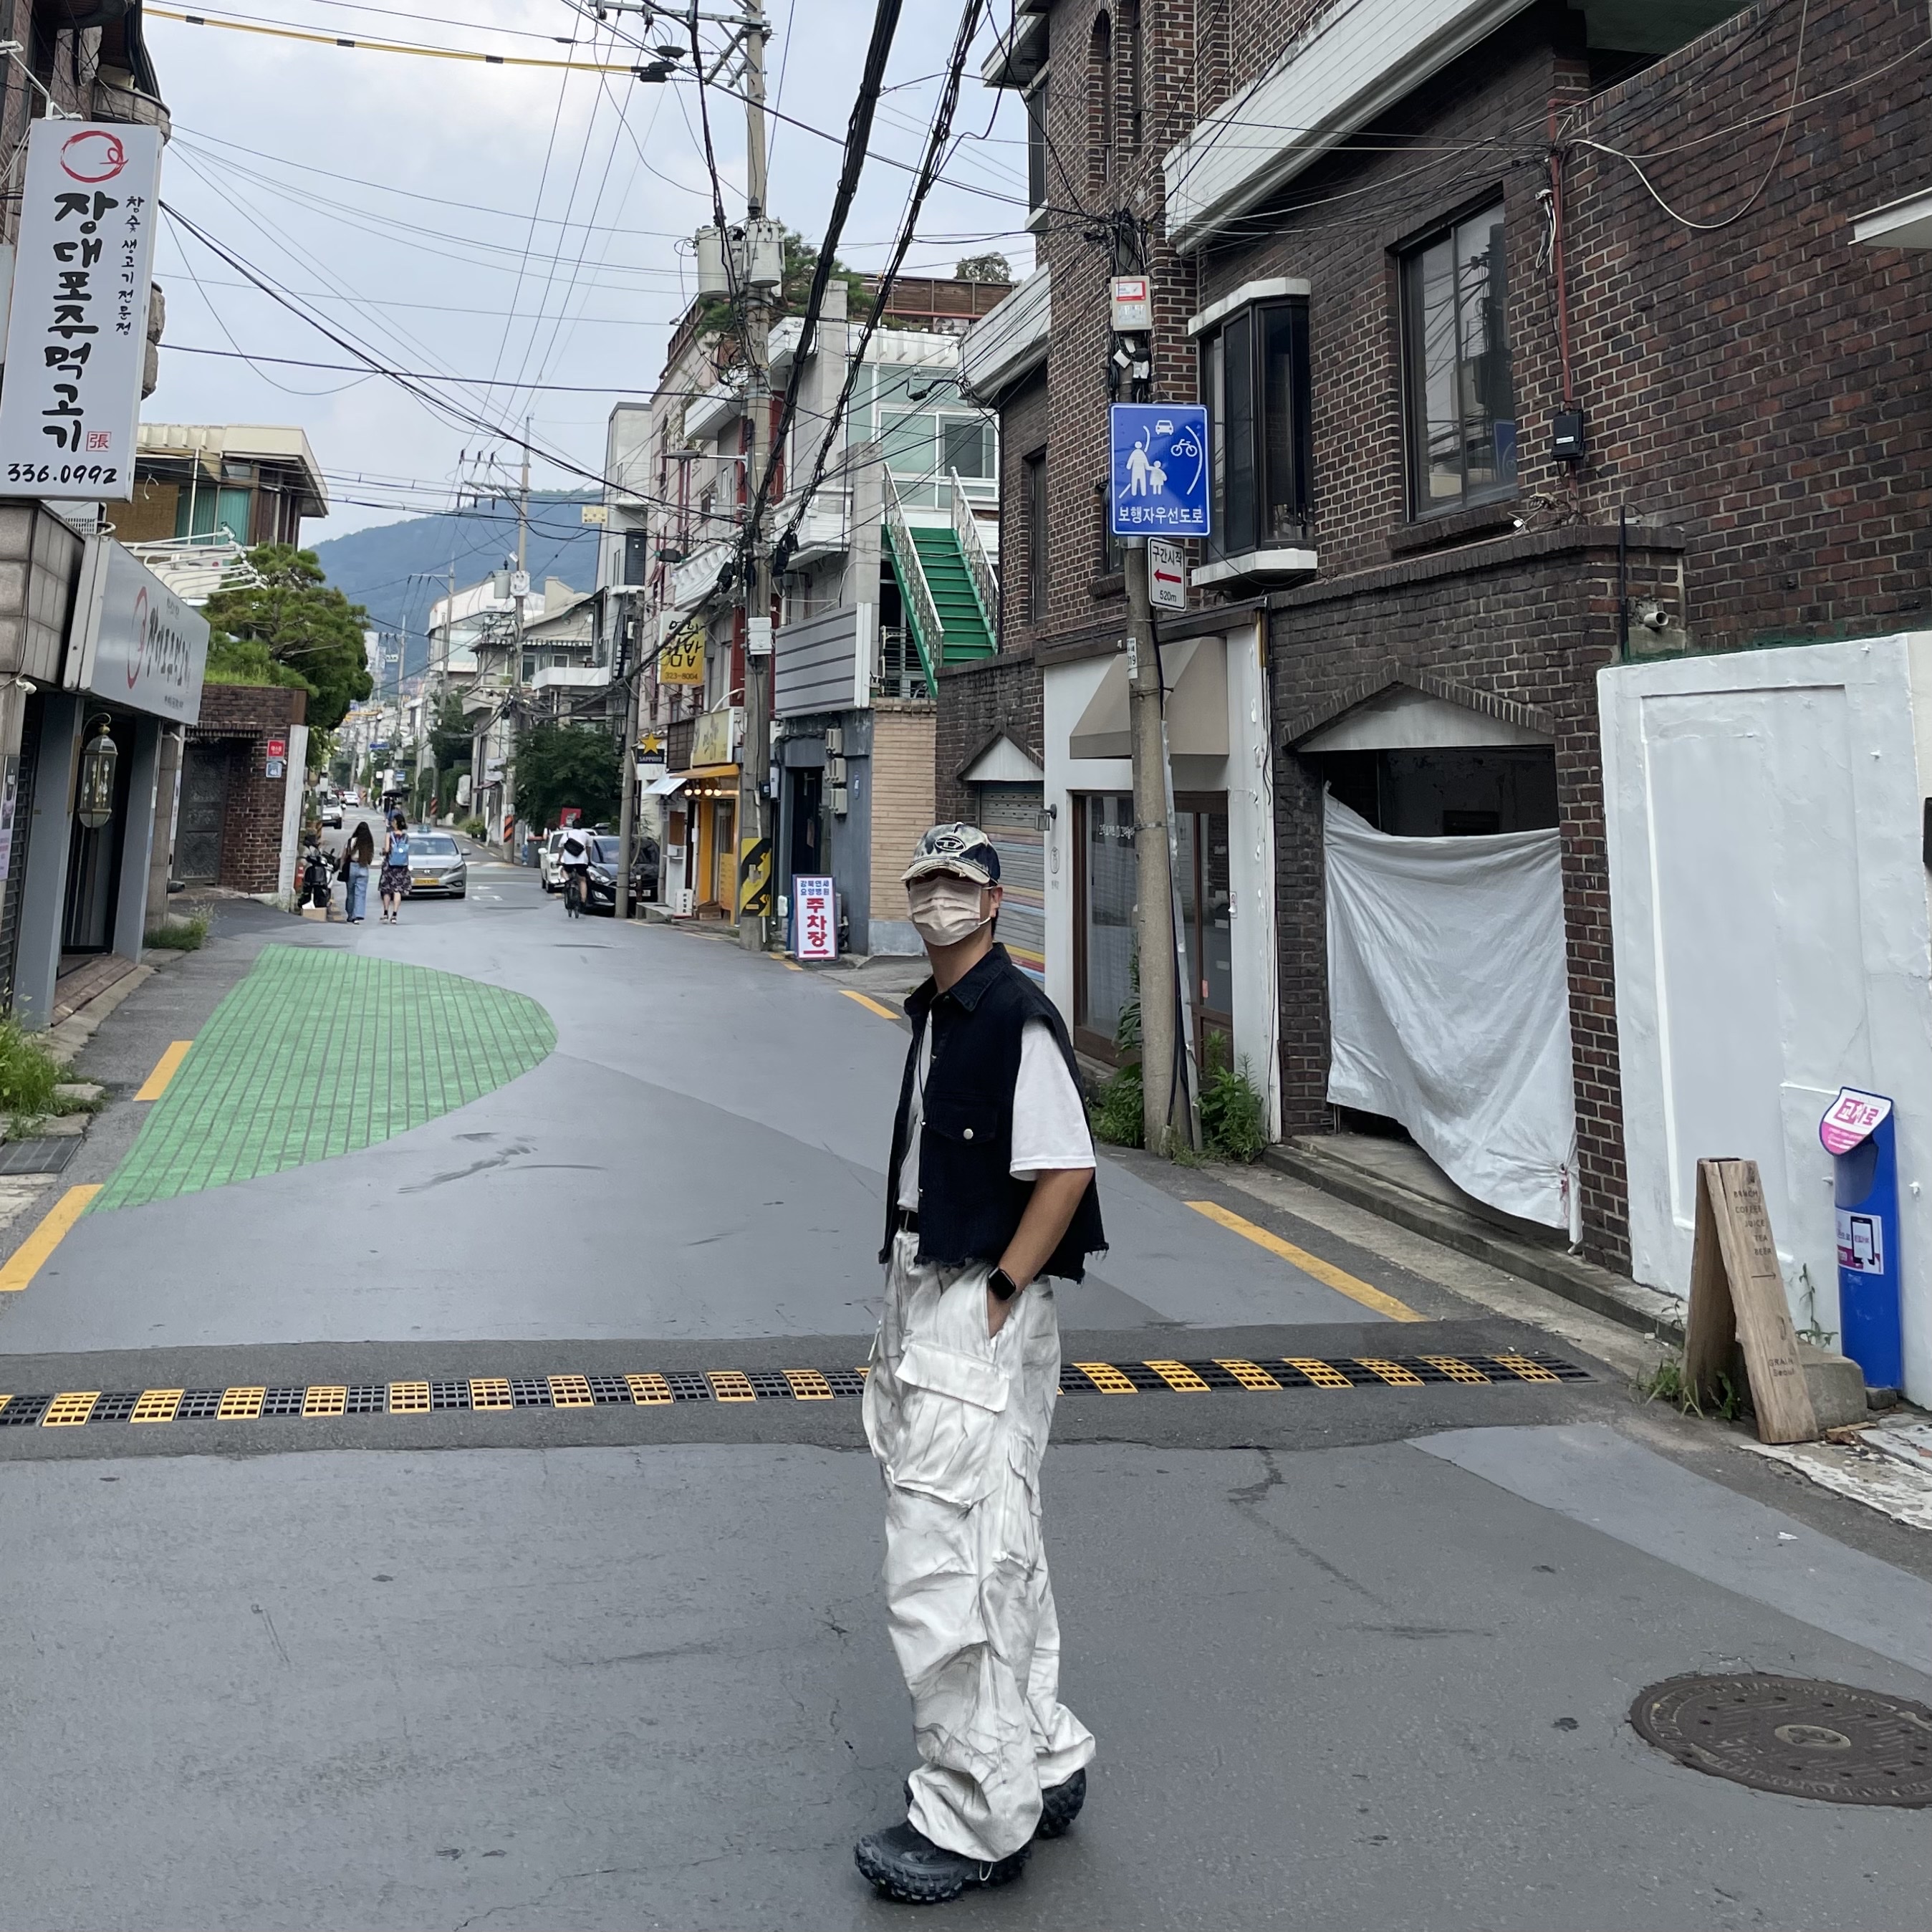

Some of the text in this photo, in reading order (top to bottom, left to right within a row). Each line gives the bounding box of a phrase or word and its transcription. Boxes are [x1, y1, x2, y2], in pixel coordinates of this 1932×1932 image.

[124, 196, 145, 234] 참숯
[121, 239, 138, 284] 생고기
[42, 191, 119, 453] 장대포주먹고기
[88, 433, 110, 450] 張
[7, 463, 117, 486] 336.0992
[1118, 506, 1204, 524] 보행자우선도로
[1152, 546, 1182, 567] 구간시작
[1160, 590, 1177, 602] 520m
[807, 898, 827, 948] 주차장
[1837, 1100, 1880, 1126] 교차로
[1735, 1205, 1762, 1213] COFFEE
[1745, 1219, 1765, 1228] JUICE
[1754, 1247, 1772, 1256] BEER
[1773, 1368, 1794, 1377] Seoul
